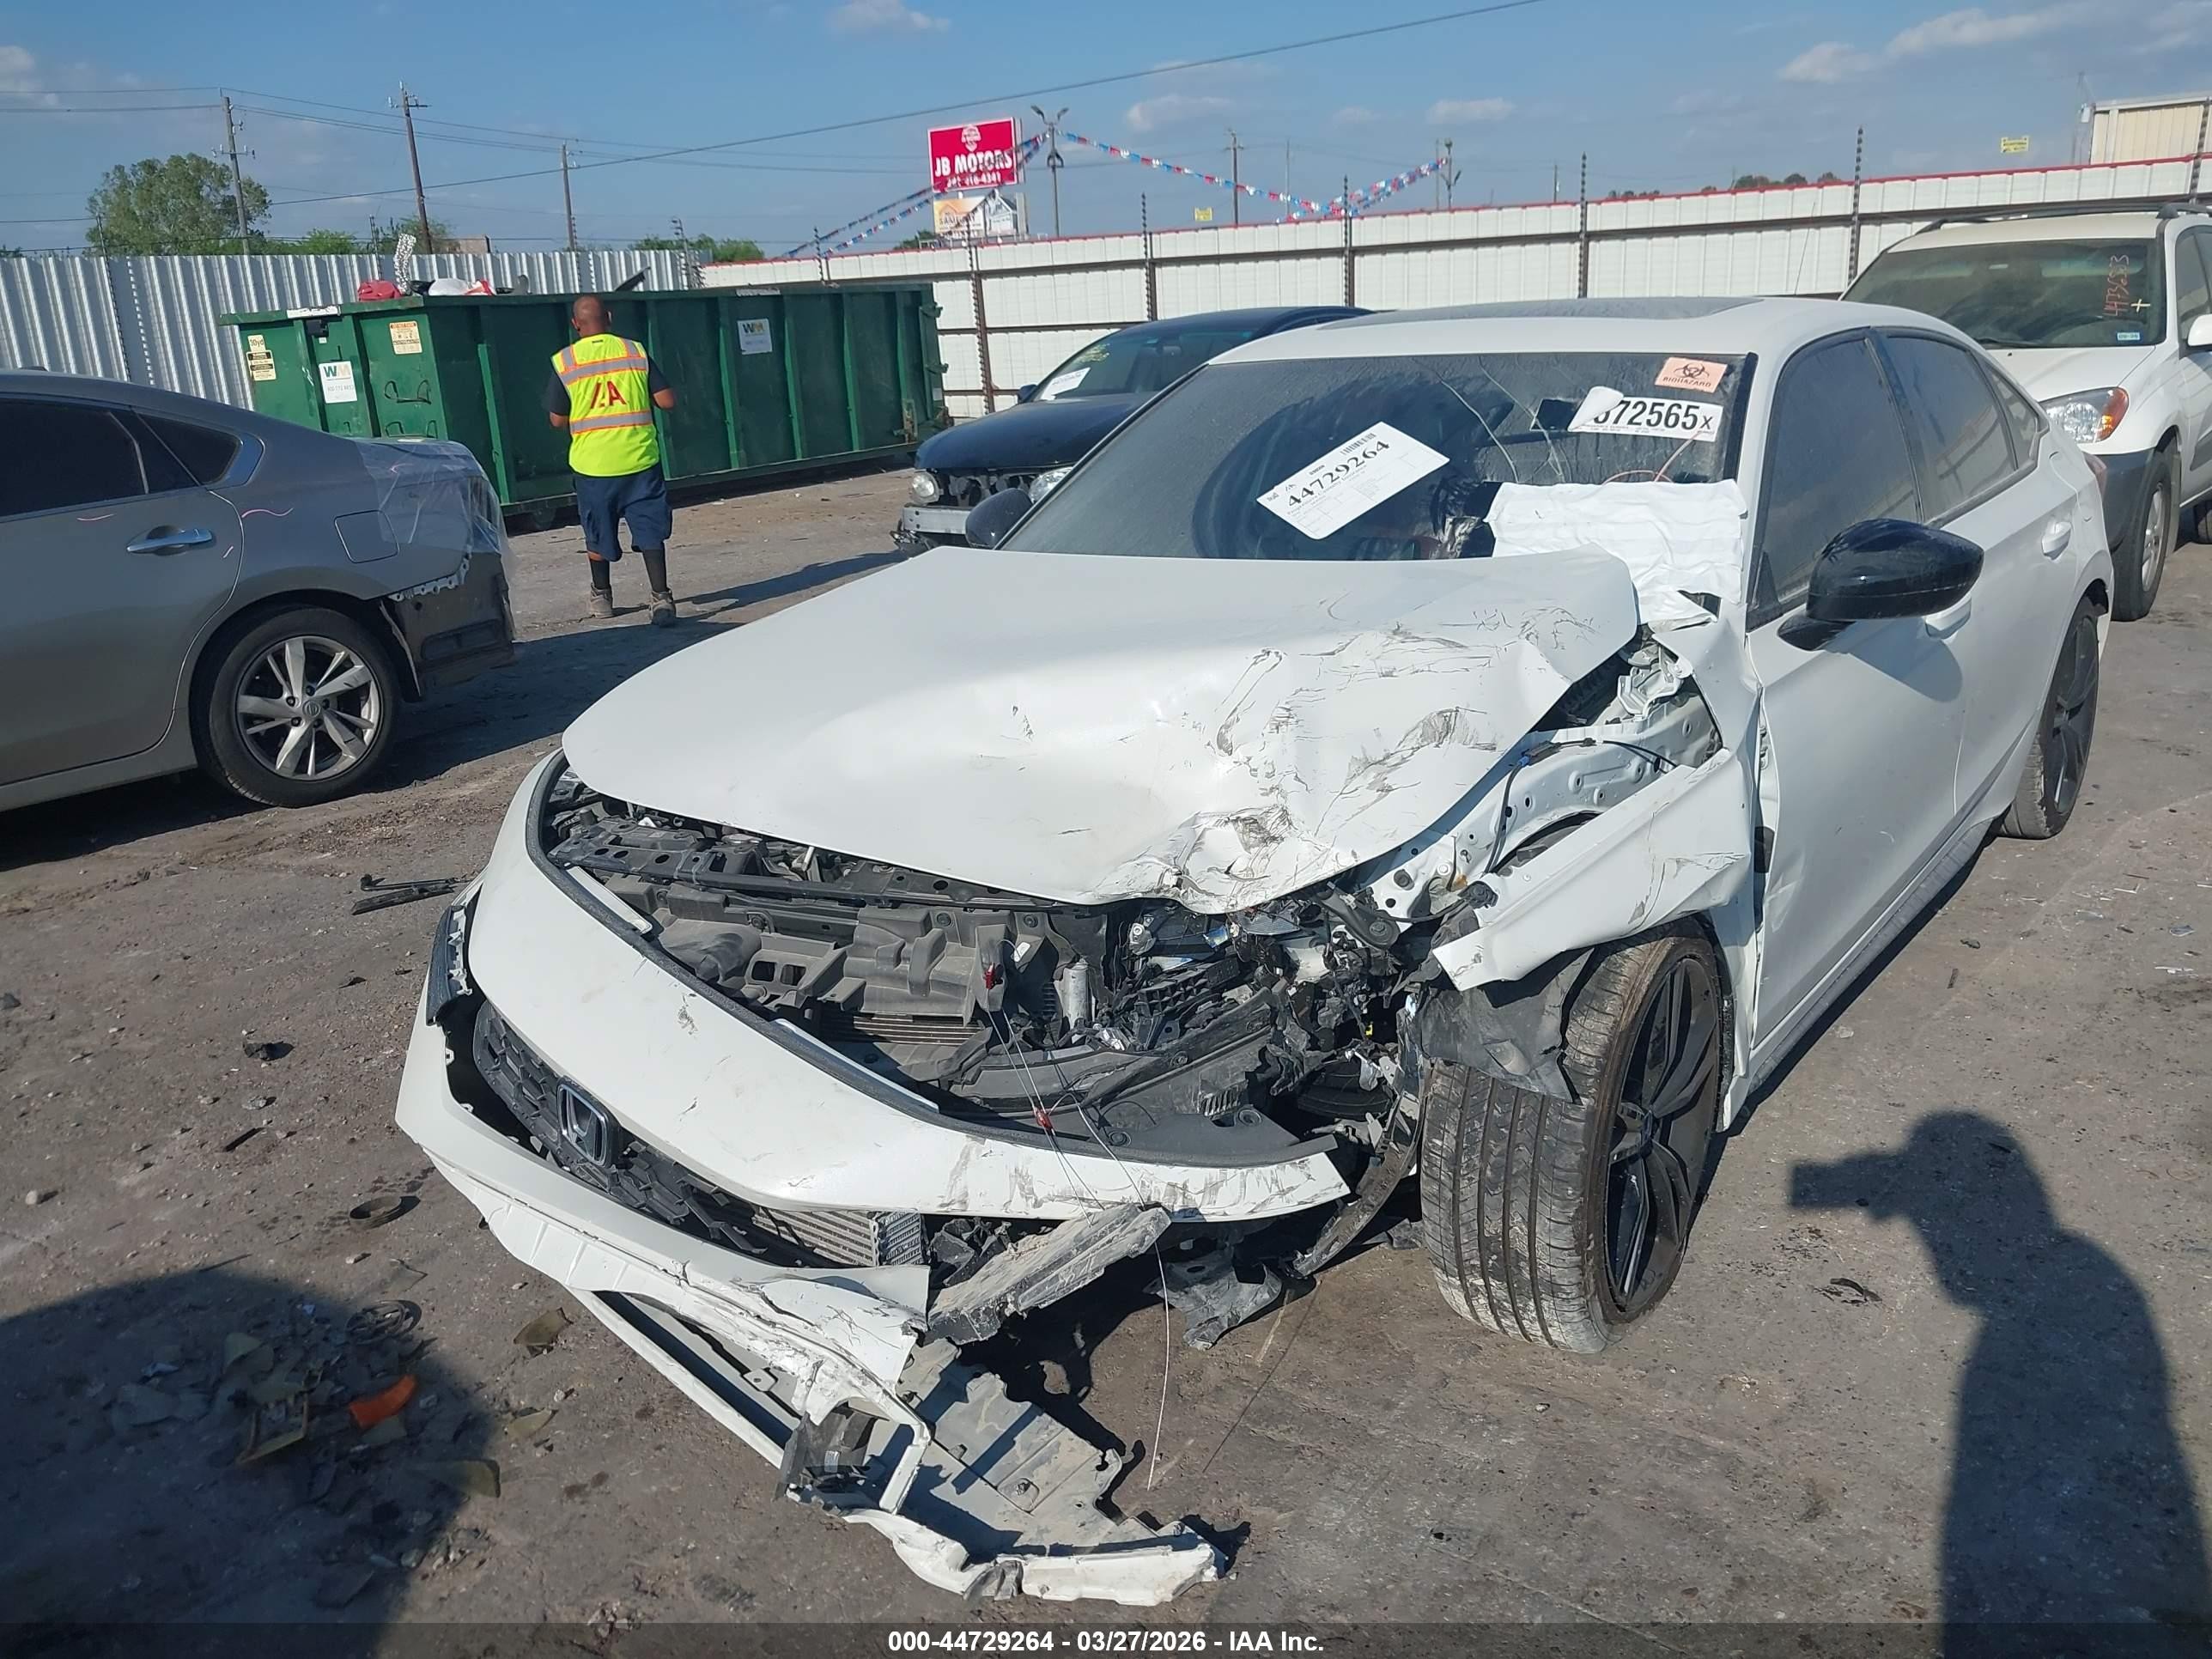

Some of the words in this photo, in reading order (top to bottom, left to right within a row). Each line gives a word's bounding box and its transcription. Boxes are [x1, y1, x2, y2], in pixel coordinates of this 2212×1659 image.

[934, 156, 951, 177] JB
[954, 149, 1012, 173] MOTORS
[323, 364, 351, 378] WM
[1662, 376, 1711, 387] BIOHAZARD
[1288, 440, 1390, 507] 44729264
